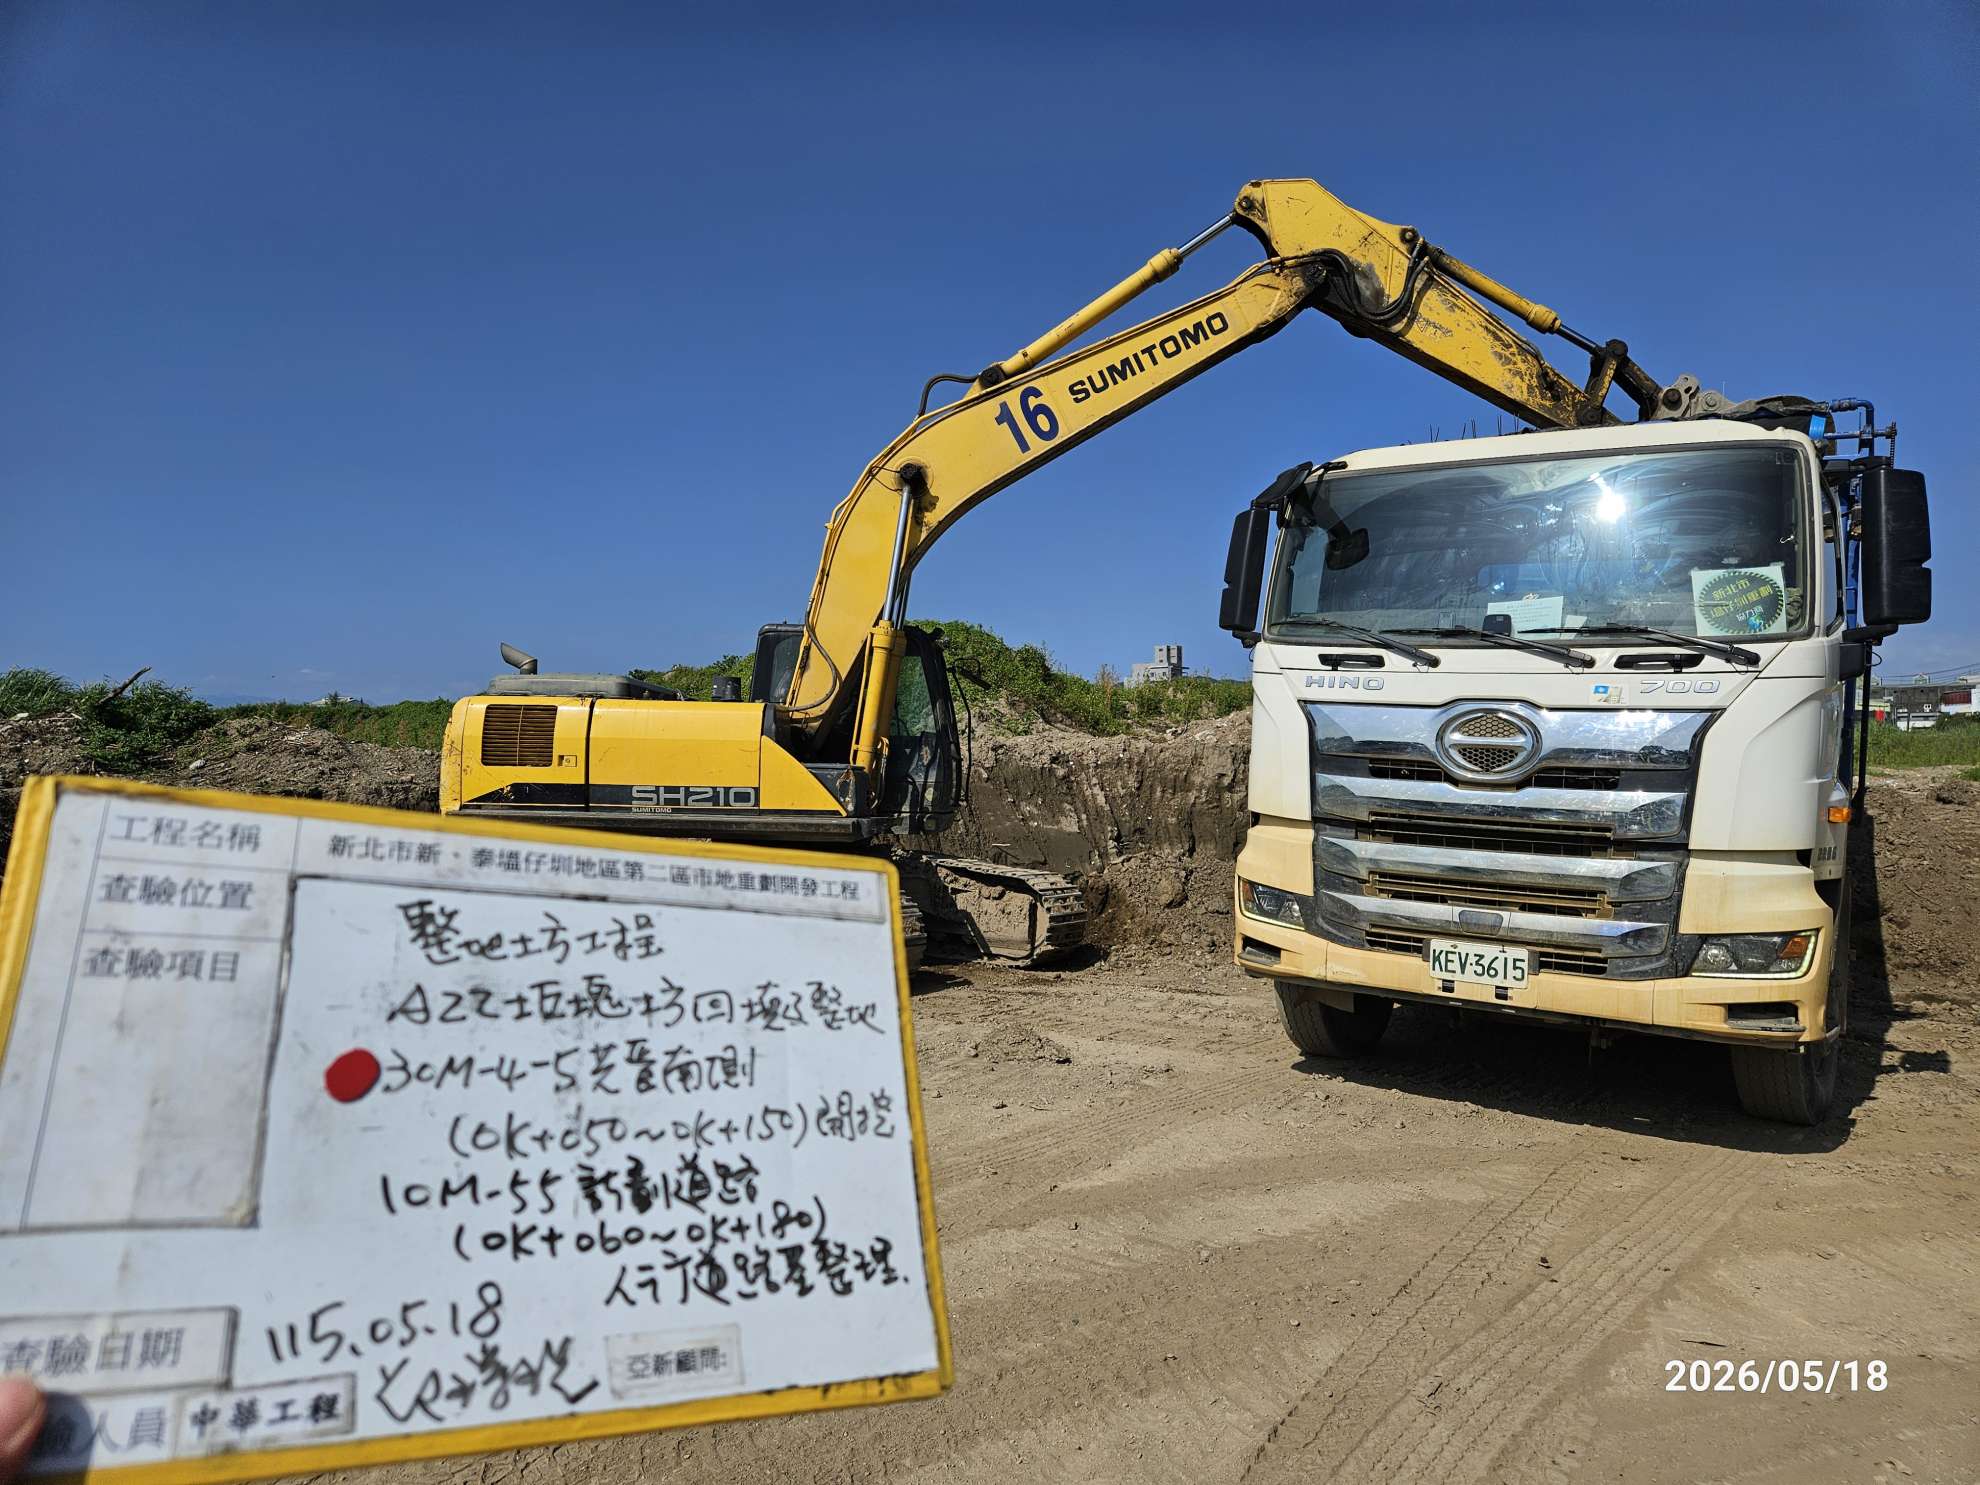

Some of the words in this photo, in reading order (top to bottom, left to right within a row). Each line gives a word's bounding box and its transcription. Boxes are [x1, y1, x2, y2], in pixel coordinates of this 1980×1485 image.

[1068, 311, 1229, 404] SUMITOMO
[994, 385, 1060, 454] 16
[1304, 675, 1385, 690] HINO
[1639, 679, 1721, 694] 700
[631, 785, 756, 807] SH210
[109, 815, 262, 853] 工程名稱
[99, 873, 254, 911] 查驗位置
[82, 946, 241, 983] 查驗項目
[0, 1327, 186, 1376] 查驗日期
[189, 1390, 341, 1440] 中華工程
